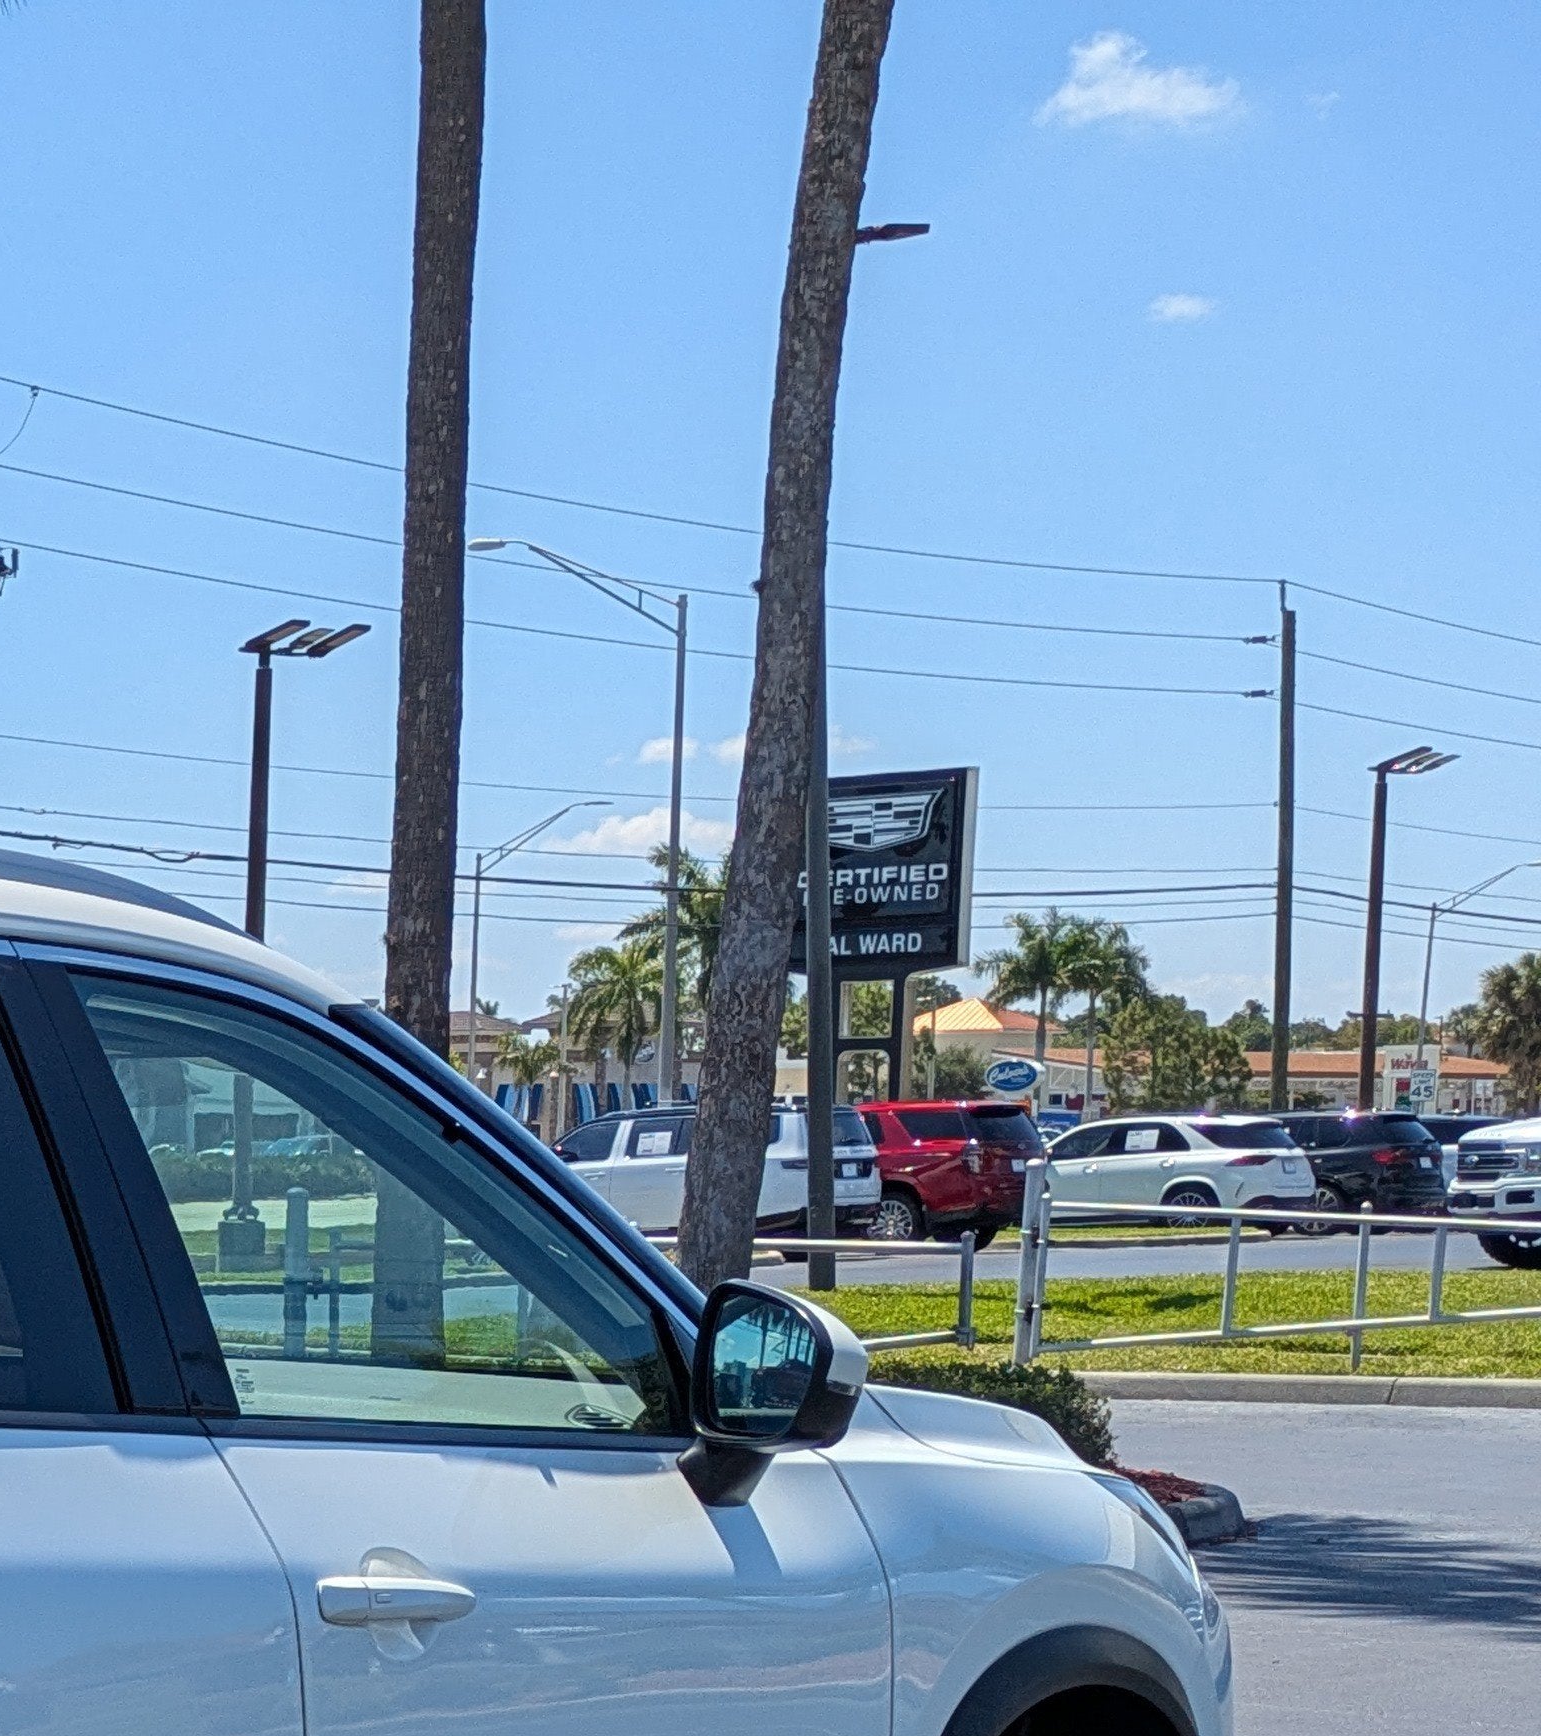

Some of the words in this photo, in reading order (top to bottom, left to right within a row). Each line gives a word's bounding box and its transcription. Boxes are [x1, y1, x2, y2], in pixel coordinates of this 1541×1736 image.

[797, 864, 948, 888] CRTIFIED
[803, 884, 939, 907] E-OWNED
[828, 937, 852, 956] AL
[859, 933, 922, 954] WARD
[1411, 1085, 1433, 1099] 45
